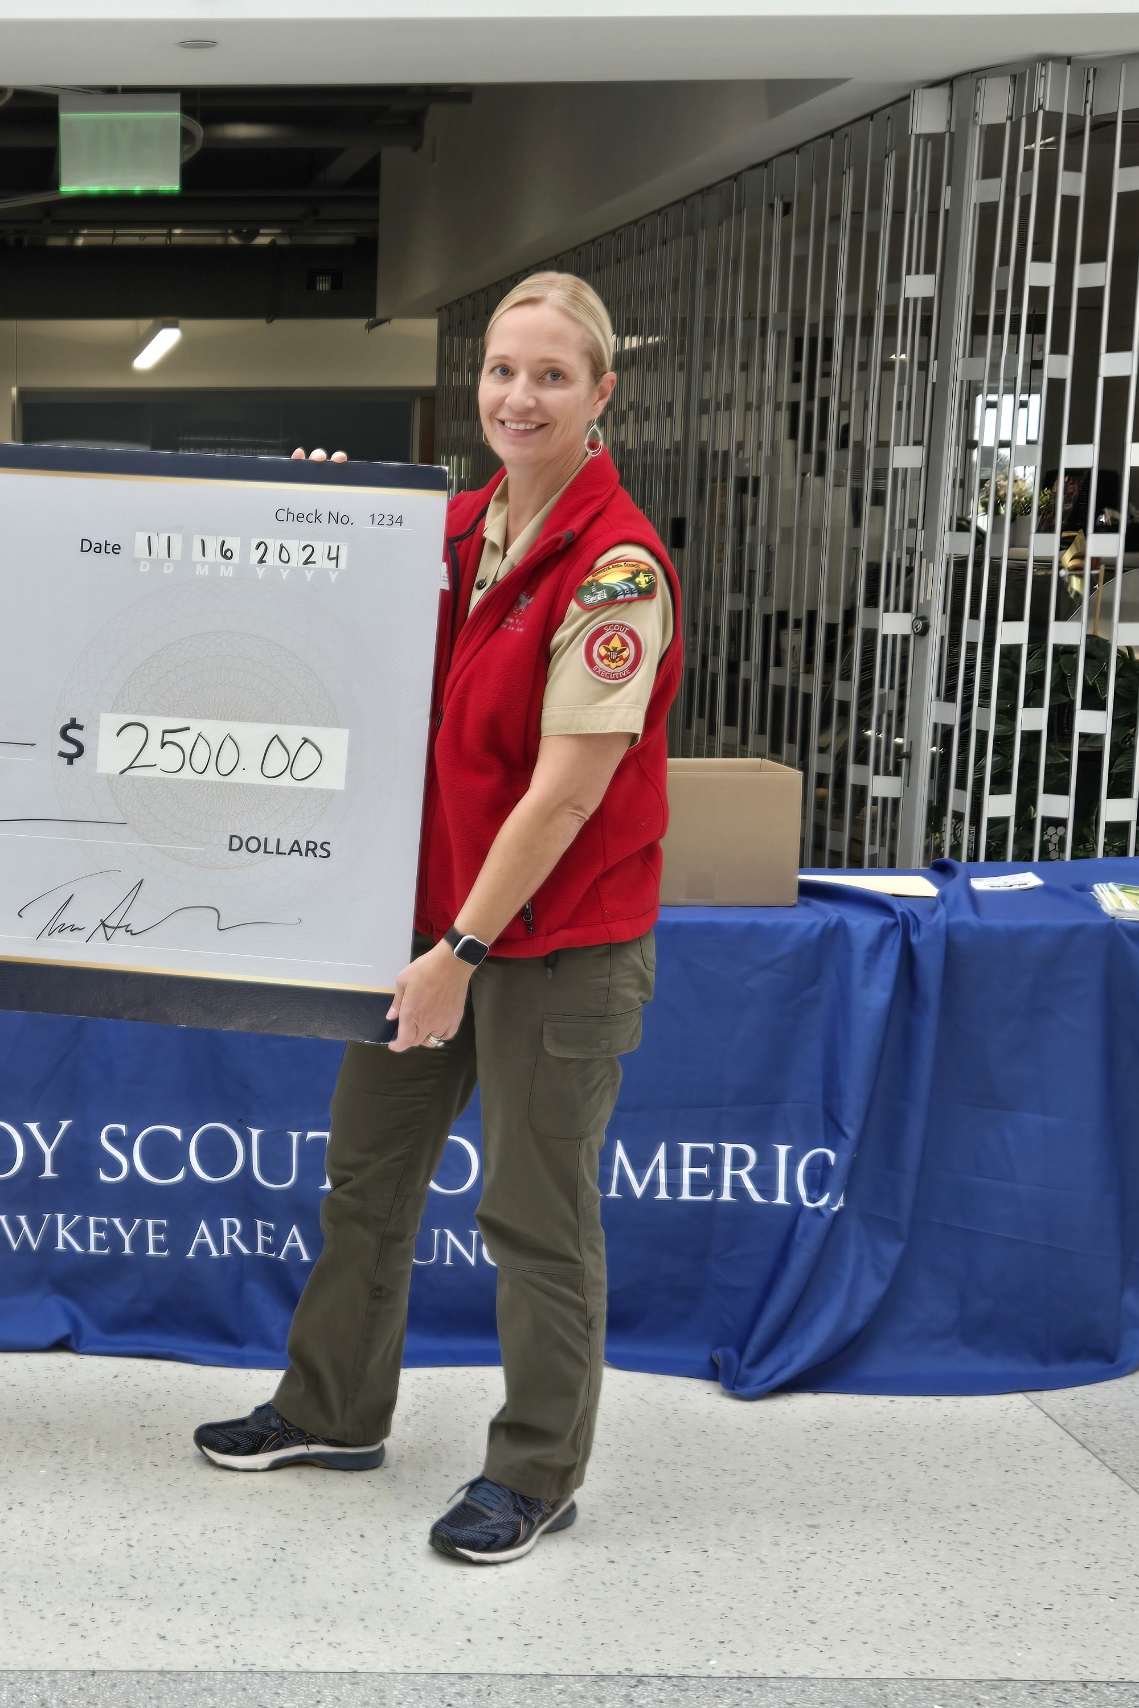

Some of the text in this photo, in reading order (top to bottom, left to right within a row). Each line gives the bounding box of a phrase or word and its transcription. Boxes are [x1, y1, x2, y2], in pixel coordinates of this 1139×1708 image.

[274, 507, 404, 527] Check No. 1234
[80, 538, 122, 555] Date
[199, 537, 234, 562] 16
[254, 539, 341, 569] 2024
[604, 625, 629, 633] SCOUT
[593, 665, 631, 679] EXECUTIVE
[56, 716, 86, 767] $
[115, 720, 324, 783] 2500.00
[227, 833, 332, 860] DOLLARS
[187, 1217, 313, 1263] AREA
